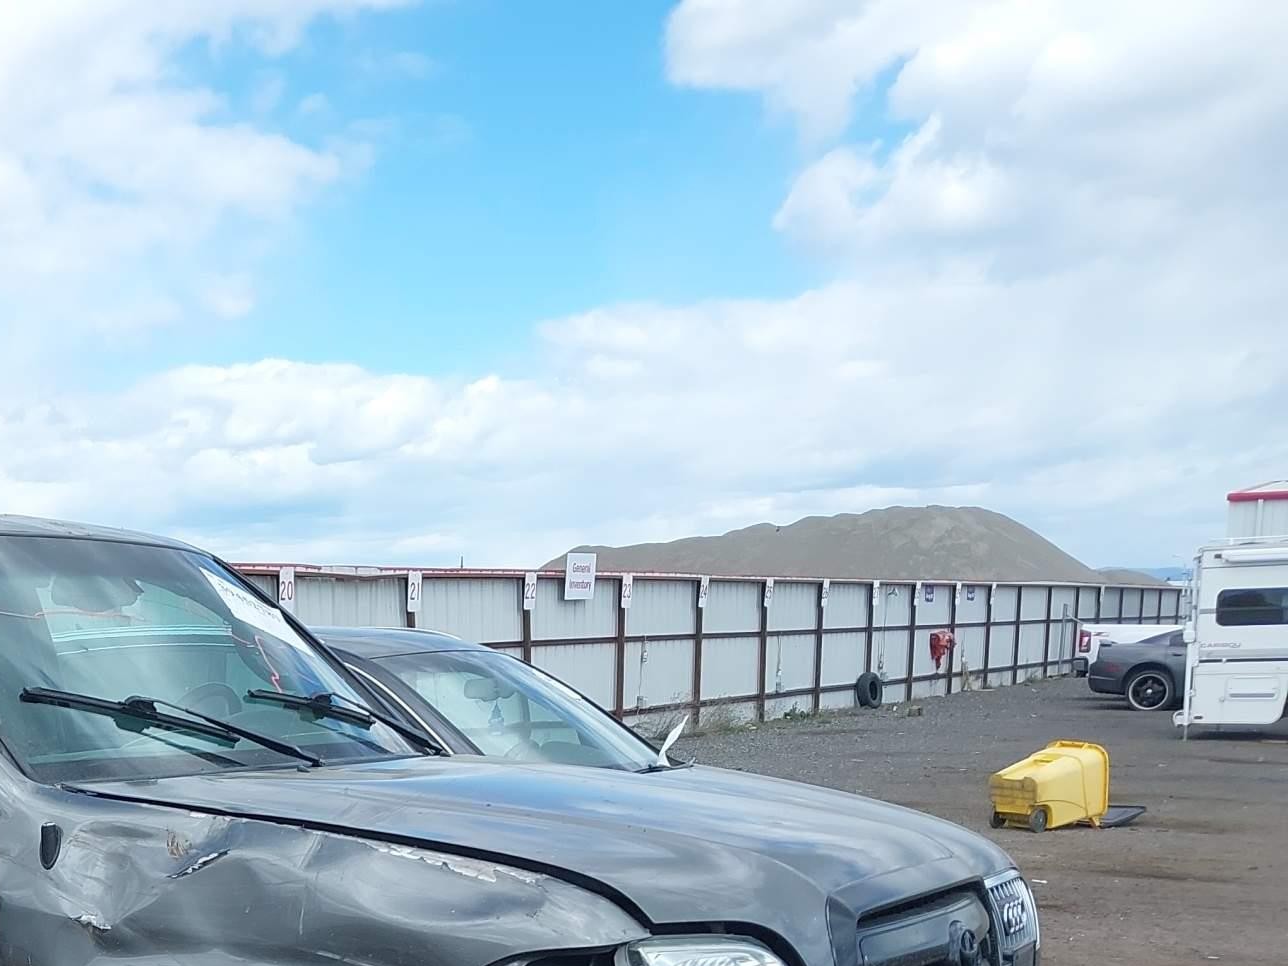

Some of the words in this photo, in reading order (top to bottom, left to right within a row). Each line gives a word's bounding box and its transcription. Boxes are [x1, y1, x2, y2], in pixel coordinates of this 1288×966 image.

[572, 562, 591, 573] General
[280, 580, 294, 601] 20
[410, 582, 421, 601] 21
[525, 583, 537, 600] 22
[622, 583, 632, 599] 23
[699, 583, 708, 599] 24
